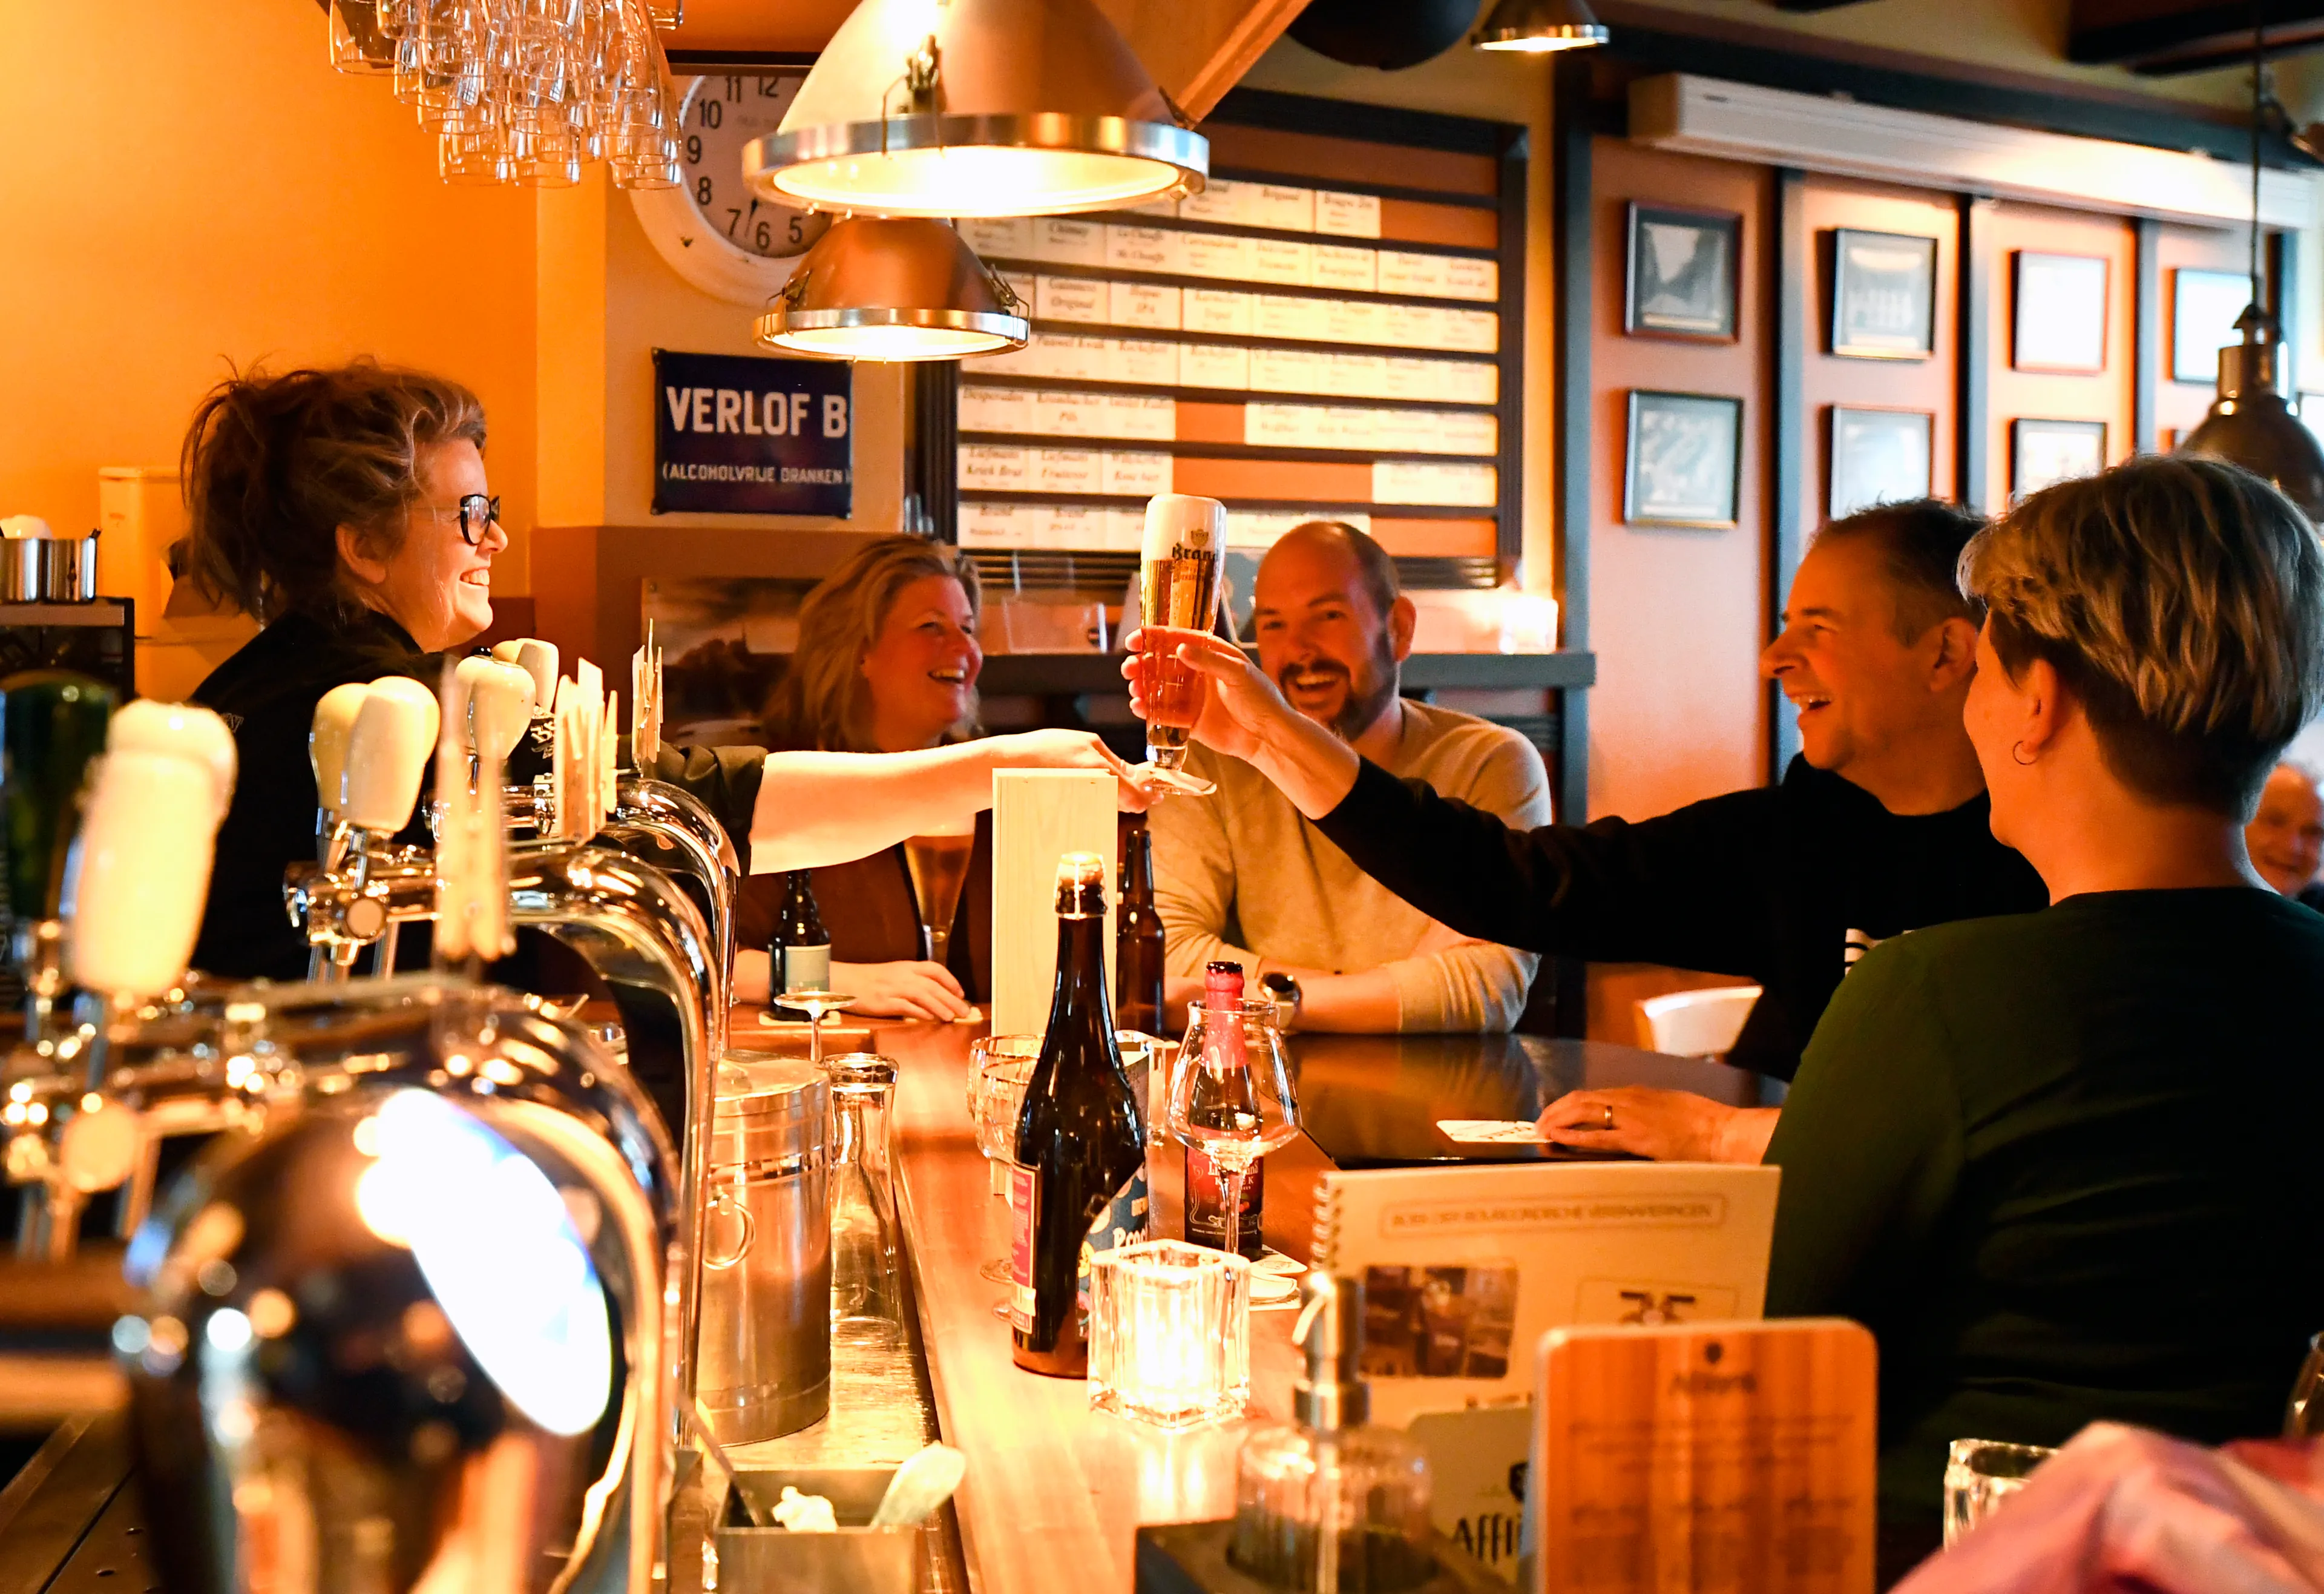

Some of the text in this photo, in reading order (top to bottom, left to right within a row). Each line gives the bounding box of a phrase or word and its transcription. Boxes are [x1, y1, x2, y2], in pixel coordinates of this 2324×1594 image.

[758, 76, 779, 97] 12
[700, 98, 723, 130] 10
[686, 134, 701, 164] 9
[697, 176, 712, 205] 8
[726, 208, 741, 235] 7
[755, 221, 770, 249] 6
[789, 216, 803, 243] 5
[666, 386, 847, 438] VERLOF B
